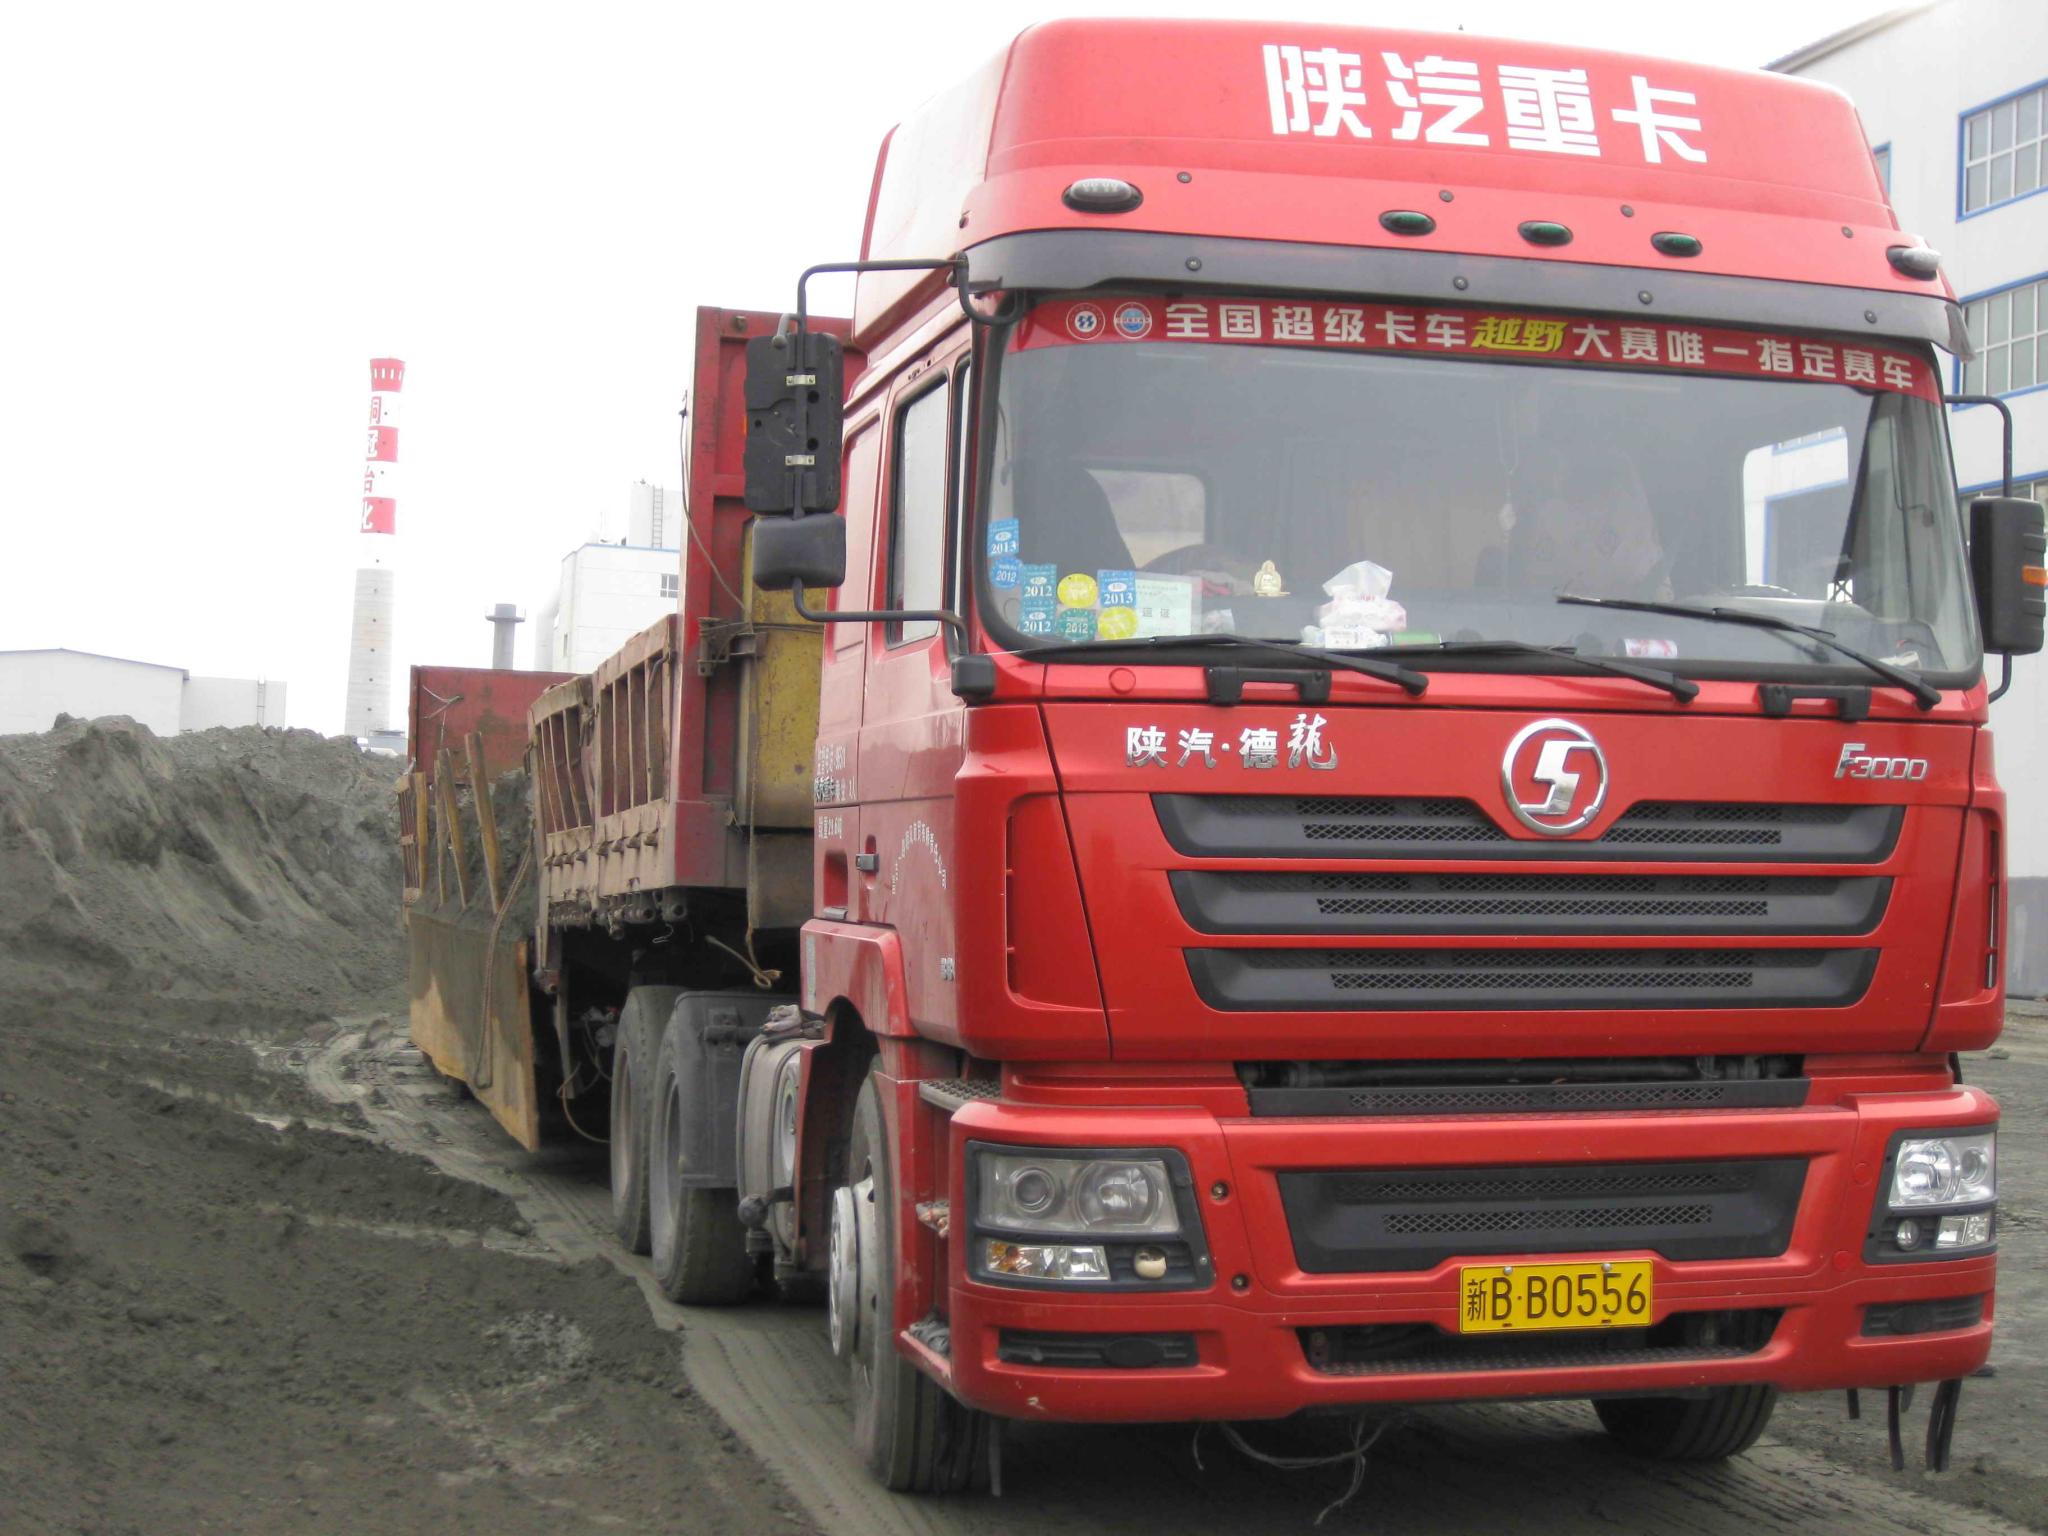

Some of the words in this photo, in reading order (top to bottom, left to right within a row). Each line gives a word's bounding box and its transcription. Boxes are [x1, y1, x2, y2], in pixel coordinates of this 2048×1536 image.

[1262, 44, 1707, 163] 陕汽重卡
[1166, 303, 1913, 388] 全国超级卡车越野大赛唯一指定赛车
[991, 541, 1017, 555] 2013
[996, 571, 1017, 582] 2012
[1024, 585, 1053, 597] 2012
[1104, 592, 1134, 605] 2013
[1023, 620, 1052, 632] 2012
[1065, 622, 1089, 635] 2012
[1834, 742, 1928, 780] F3000
